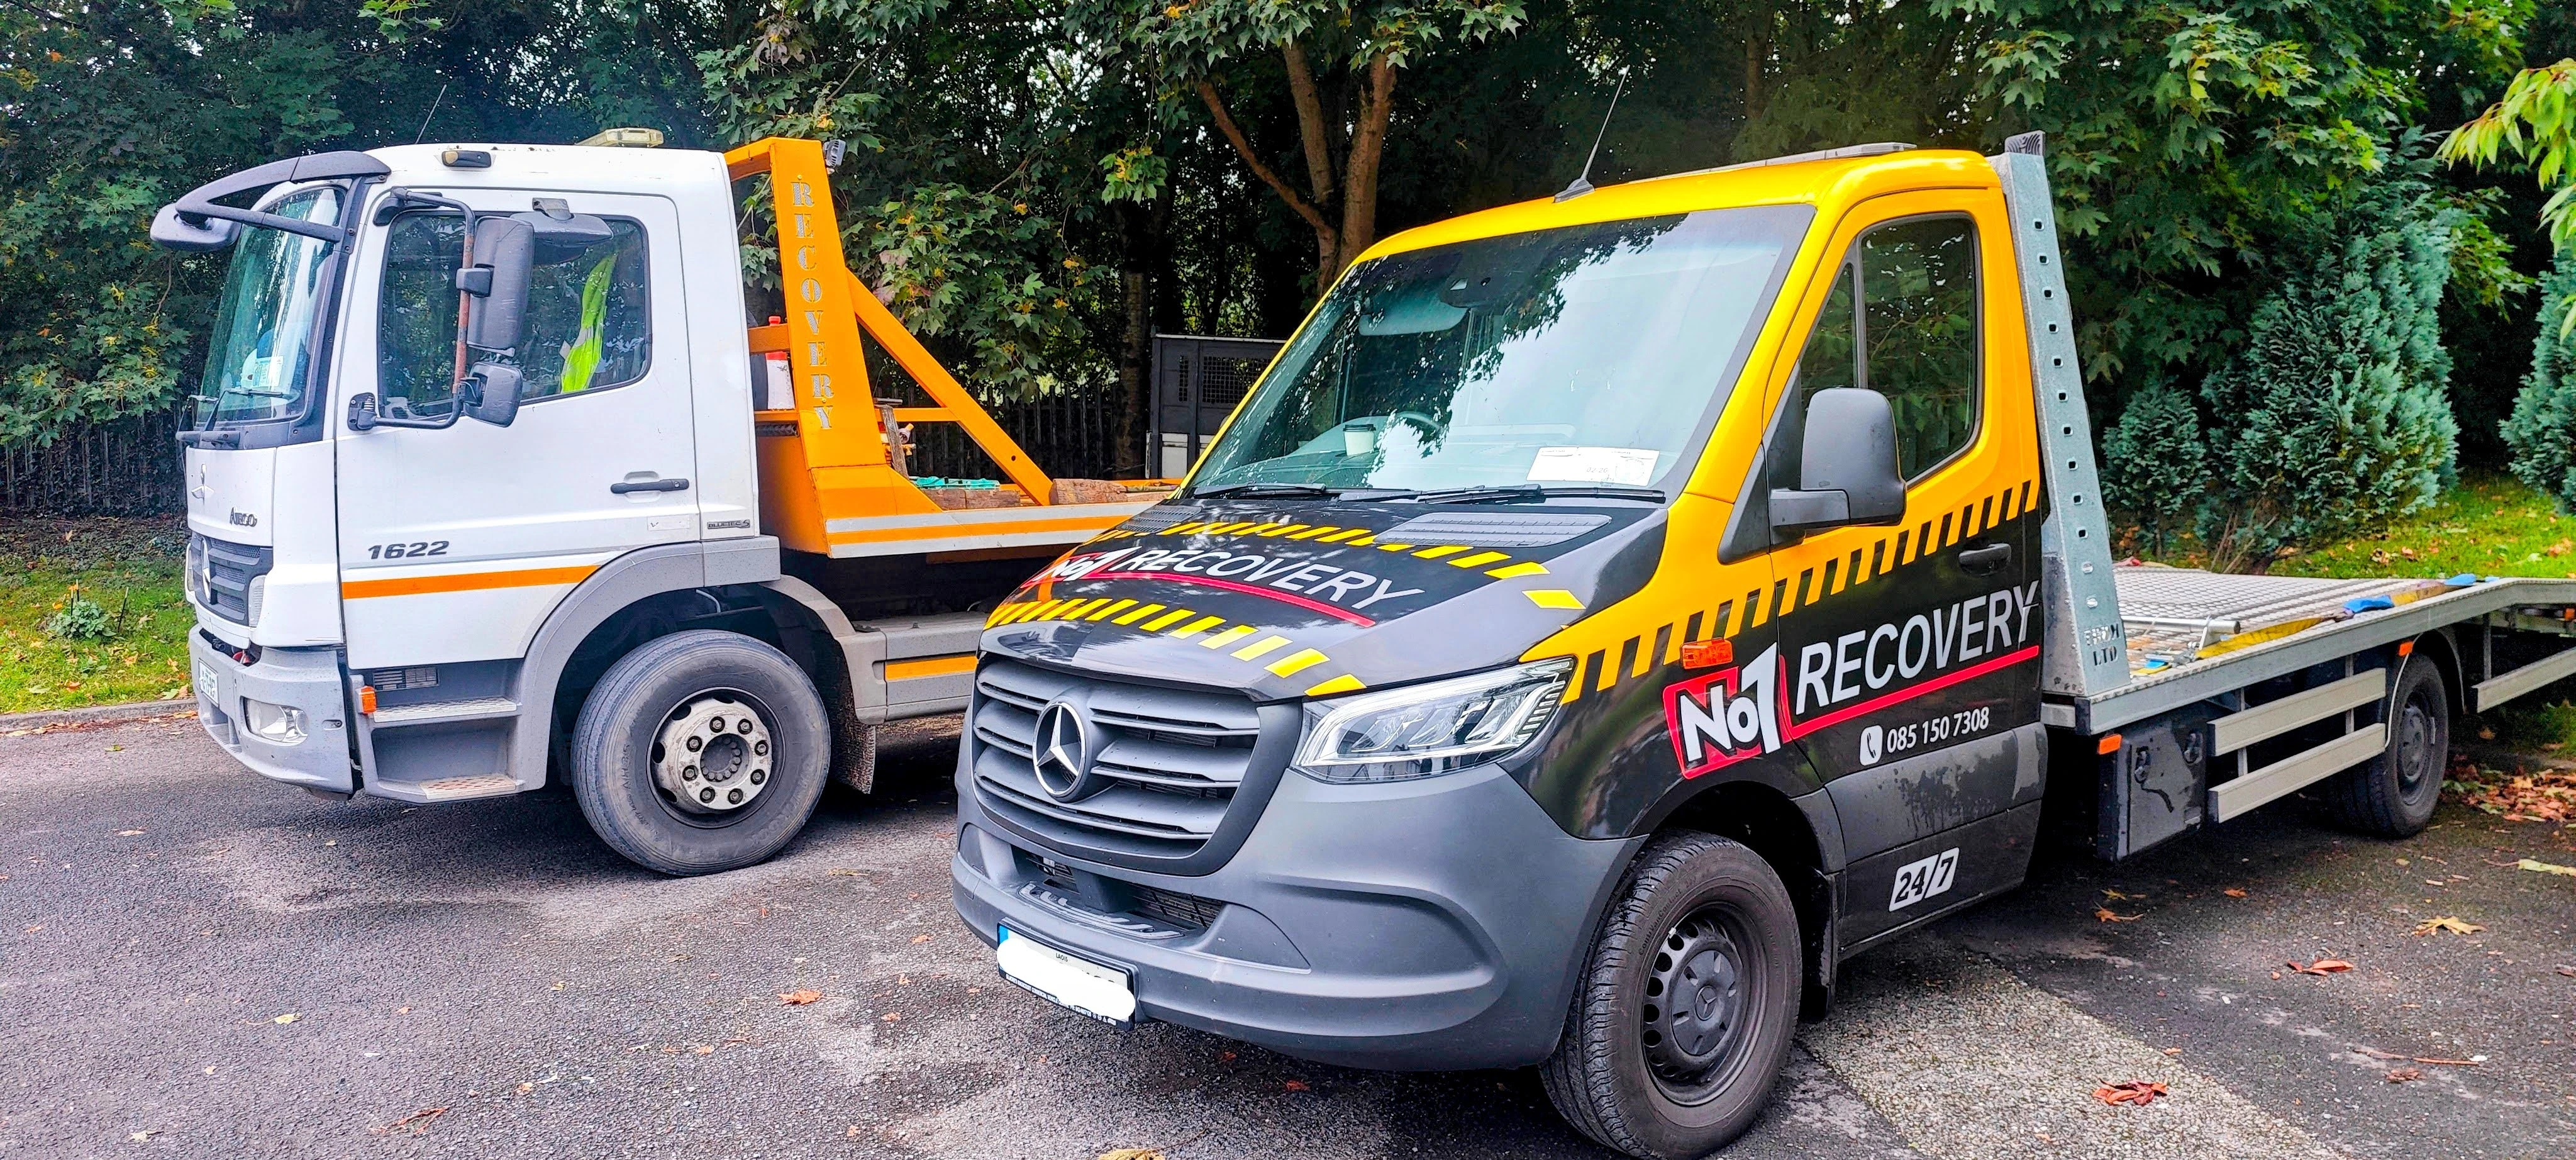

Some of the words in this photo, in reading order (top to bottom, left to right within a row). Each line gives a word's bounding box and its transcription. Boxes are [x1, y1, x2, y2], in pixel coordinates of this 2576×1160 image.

[791, 182, 833, 428] RECOVERY
[368, 540, 450, 559] 1622
[1108, 550, 1425, 609] RECOVERY
[1680, 642, 1781, 762] No1
[1796, 580, 2039, 716] RECOVERY
[2093, 645, 2118, 666] LTD
[1887, 723, 1918, 754] 085
[1922, 716, 1950, 744] 150
[1953, 706, 1989, 737] 7308
[1894, 854, 1955, 904] 24/7
[1055, 953, 1069, 962] LAOIS
